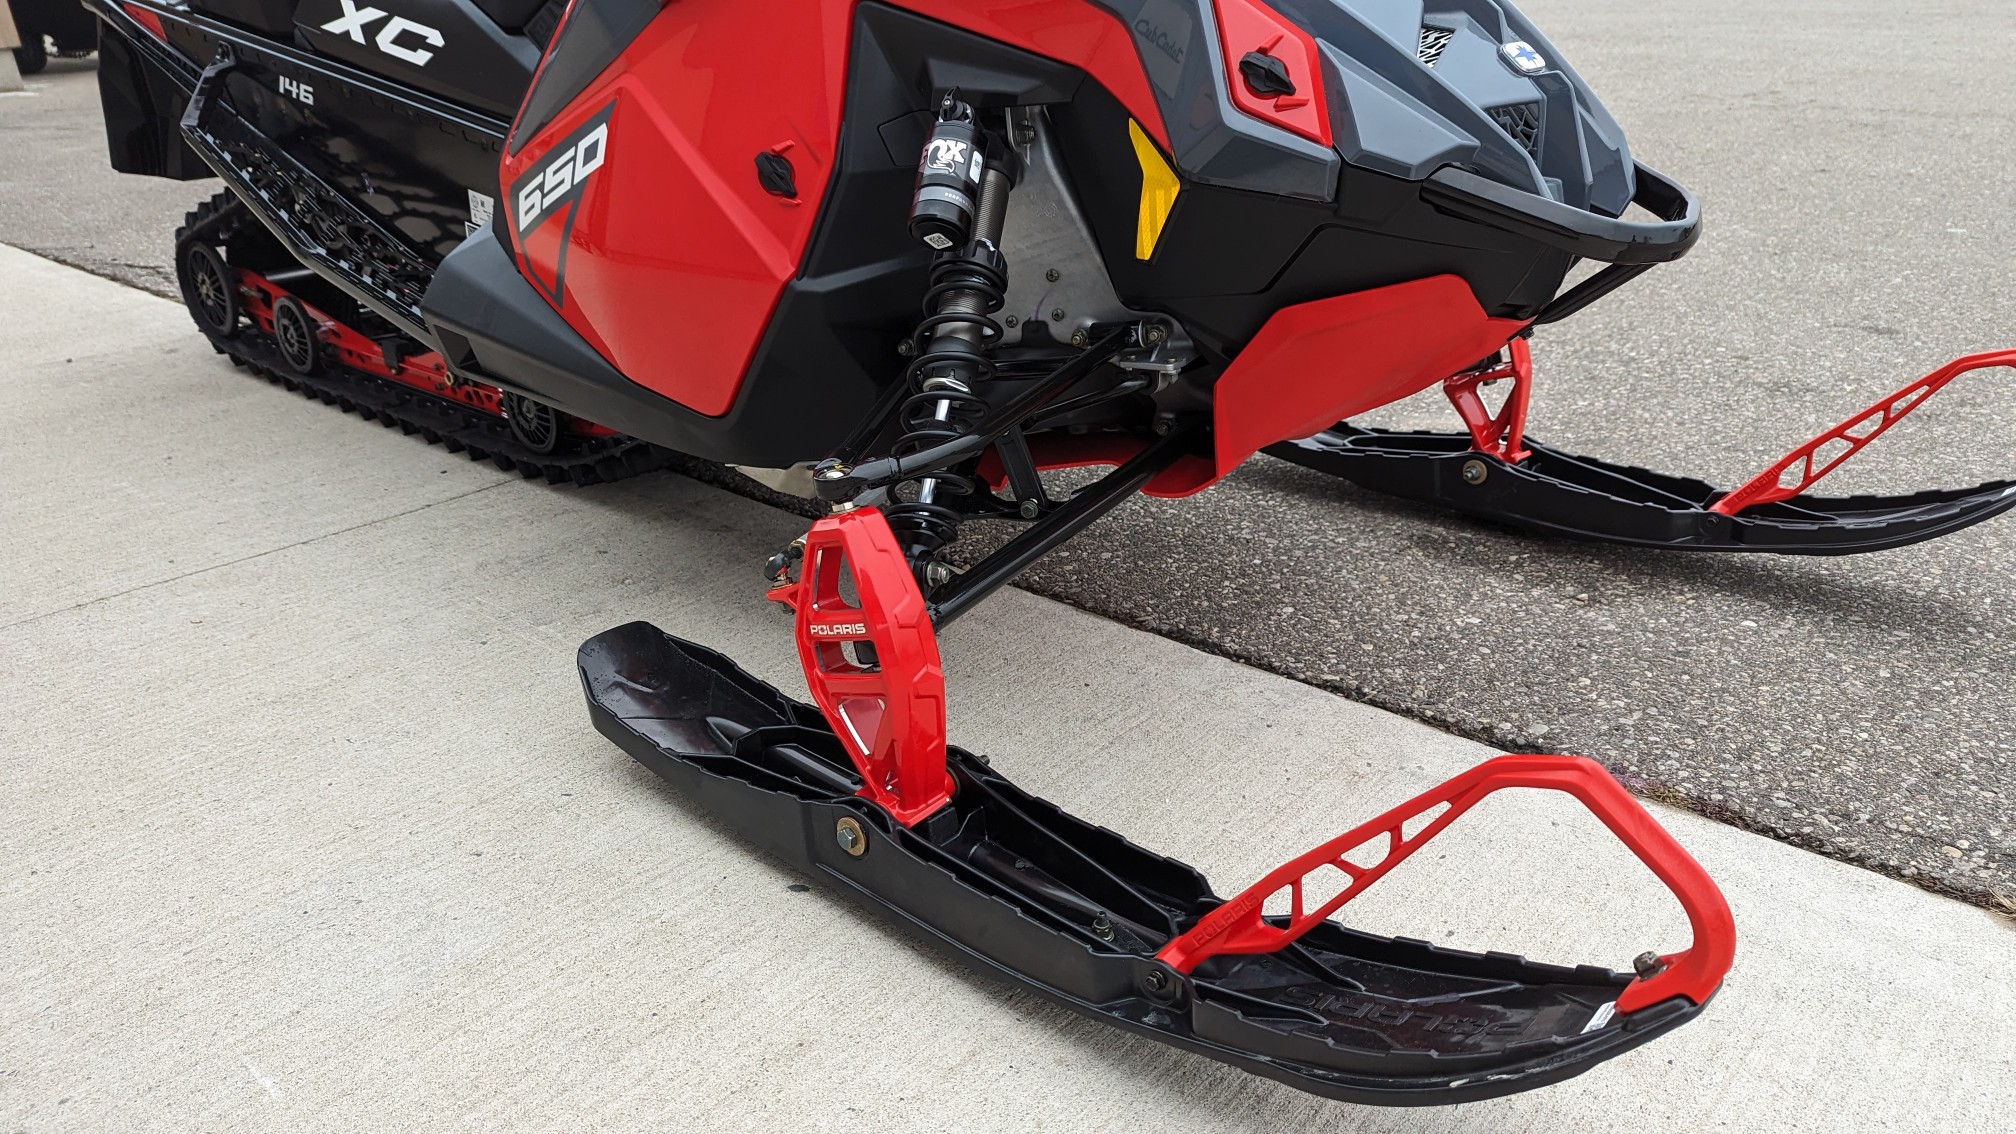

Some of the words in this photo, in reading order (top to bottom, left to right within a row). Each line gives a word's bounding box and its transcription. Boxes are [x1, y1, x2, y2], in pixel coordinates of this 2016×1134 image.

[320, 0, 446, 67] XC
[278, 74, 315, 106] 146
[518, 122, 608, 233] 650
[809, 623, 867, 636] POLARIS
[1192, 892, 1260, 947] POLARIS
